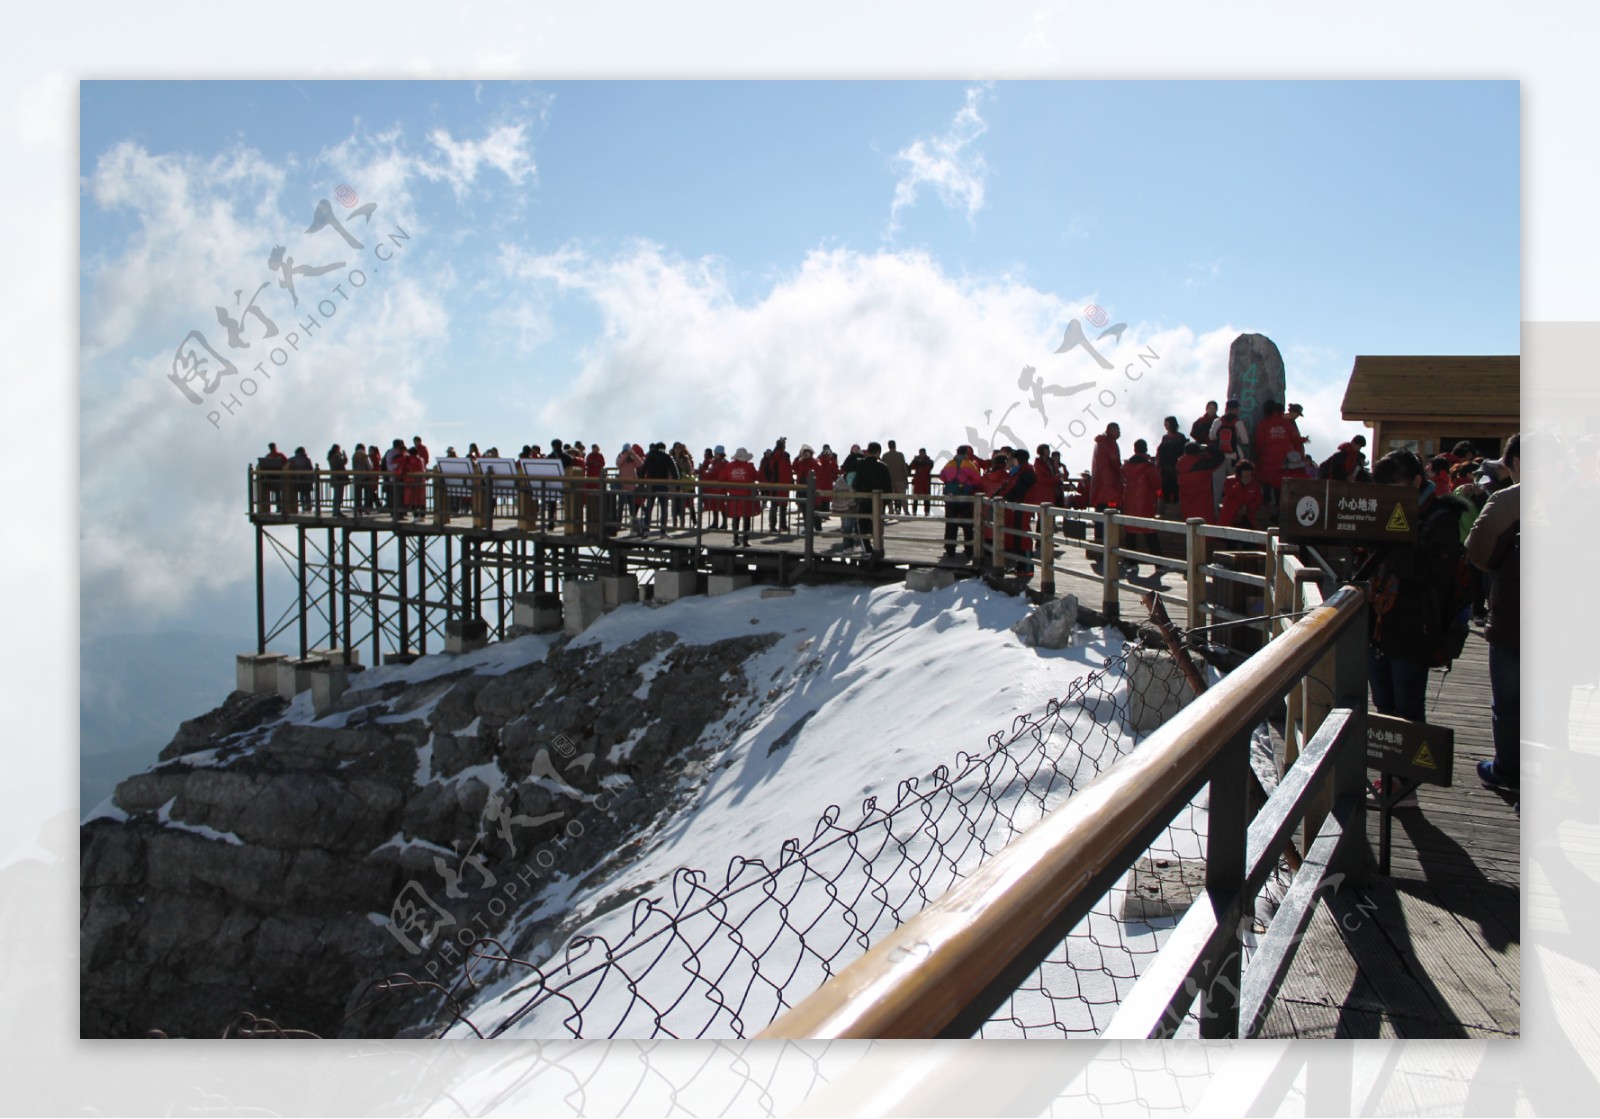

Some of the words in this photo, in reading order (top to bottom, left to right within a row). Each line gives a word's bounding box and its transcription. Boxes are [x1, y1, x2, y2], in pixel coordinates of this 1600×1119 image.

[1338, 497, 1377, 512] 小心地滑
[1367, 728, 1402, 745] 小心地滑
